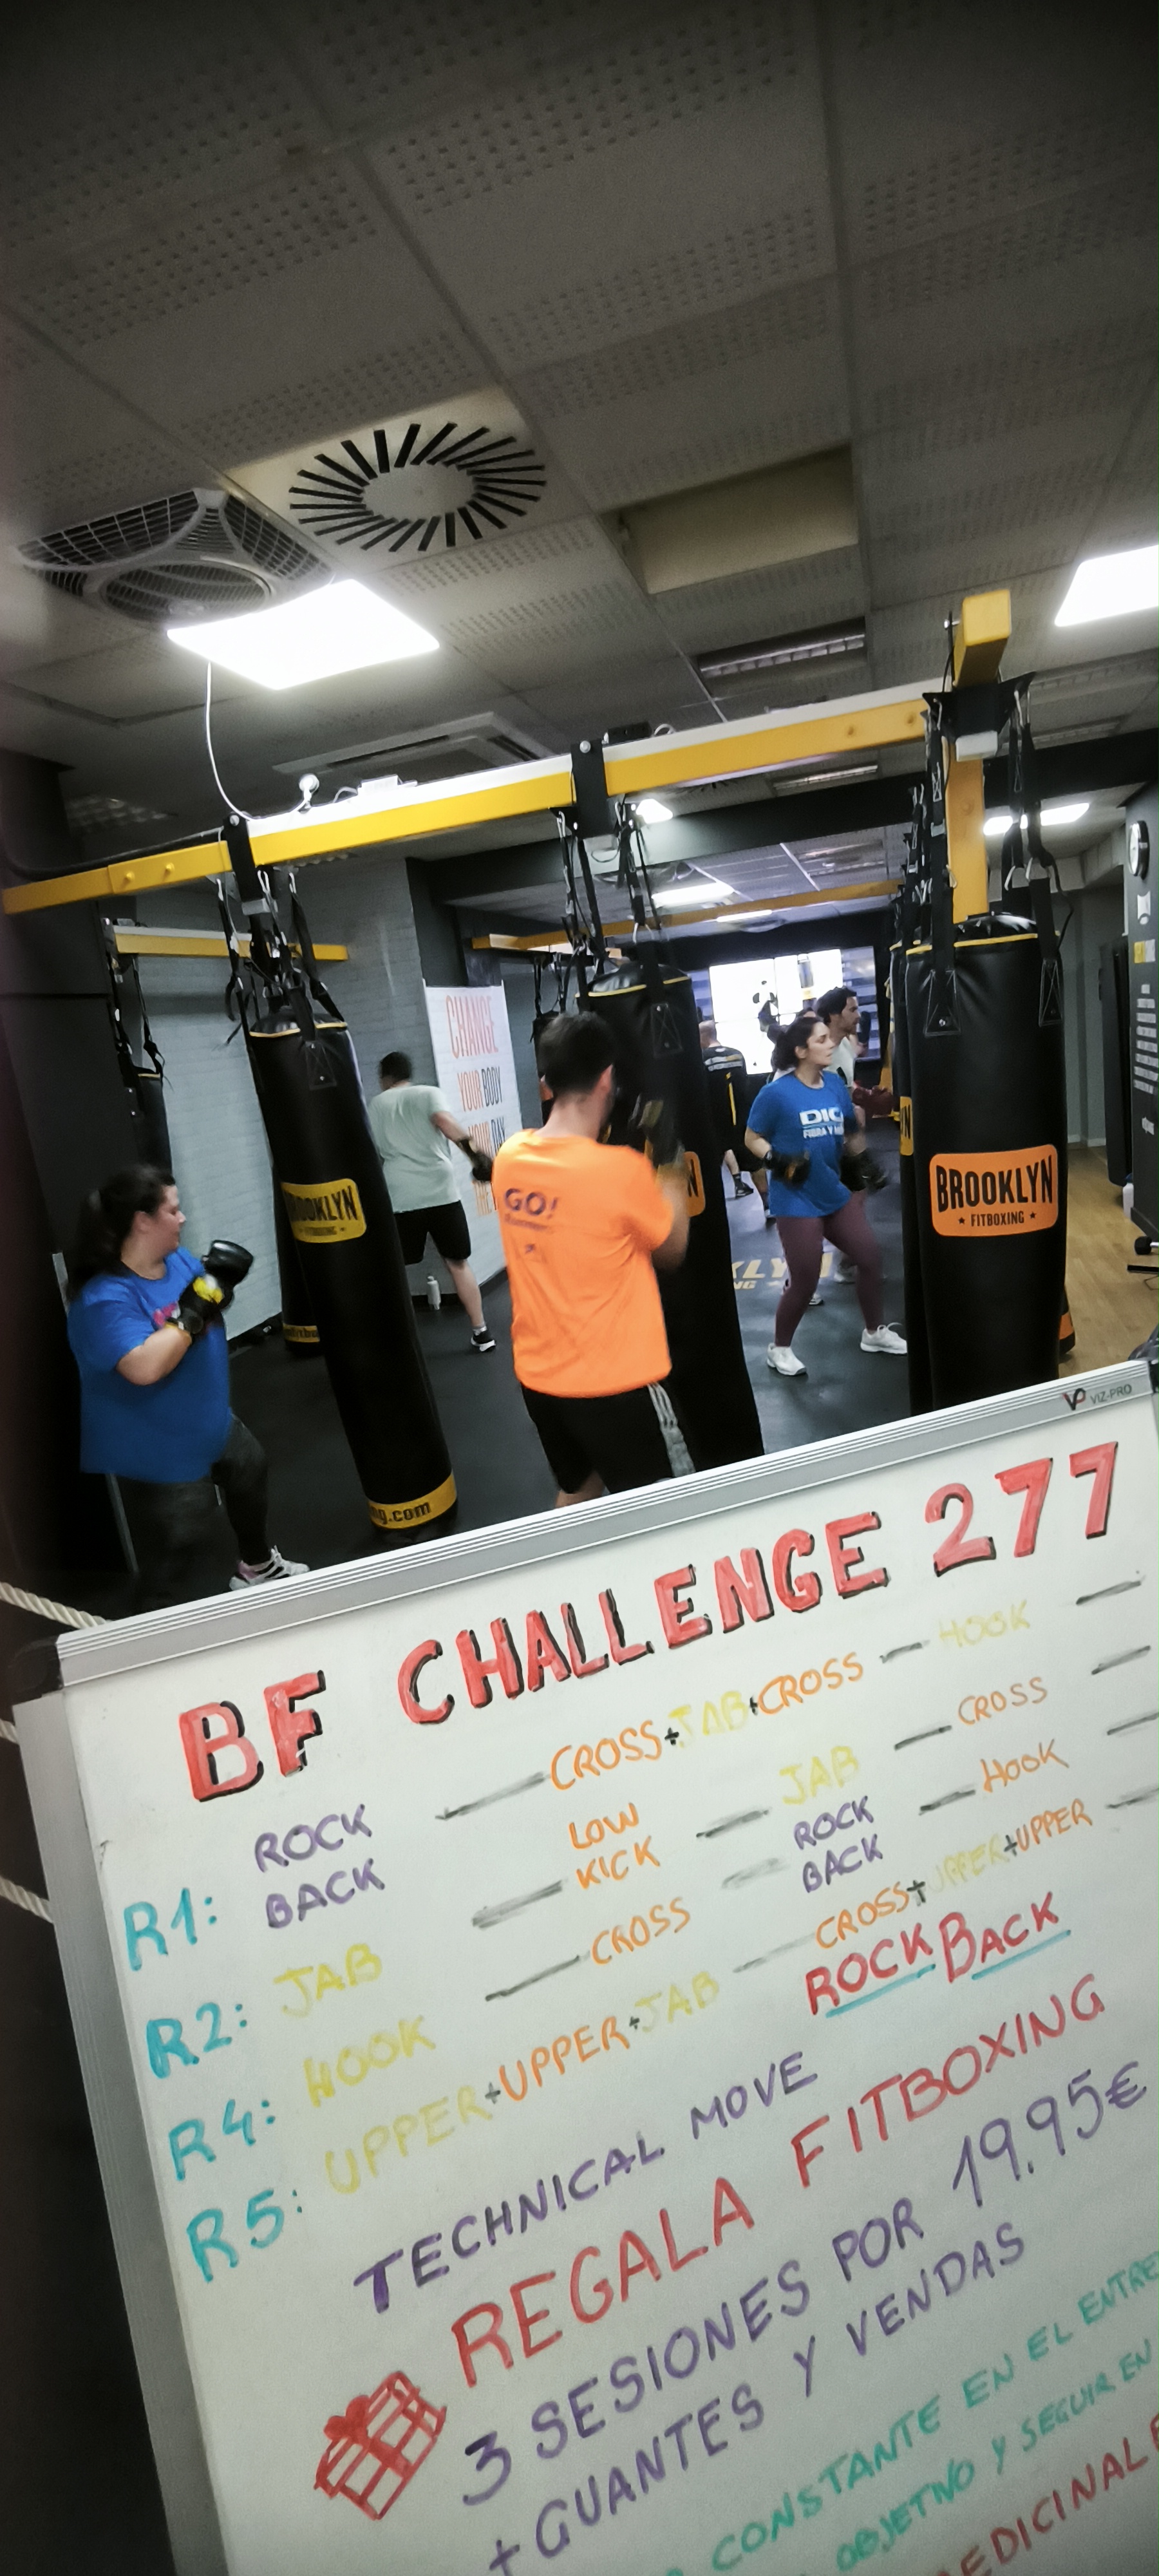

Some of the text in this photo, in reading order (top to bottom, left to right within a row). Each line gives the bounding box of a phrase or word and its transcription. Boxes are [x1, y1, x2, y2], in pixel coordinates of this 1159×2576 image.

[446, 995, 498, 1059] CHANGE
[458, 1066, 503, 1112] YOUR BODY
[283, 1186, 358, 1222] OOKLYN
[505, 1188, 558, 1219] GO!
[936, 1155, 1053, 1213] BROOKLYN
[971, 1211, 1024, 1227] FITBOXING
[1090, 1384, 1133, 1404] VIZ-PRO
[178, 1441, 1118, 1802] BF CHALLENGE 277
[939, 1600, 1032, 1650] HOOK
[146, 1677, 1048, 2079] R2: JAB LOW KICK JAB CROSS
[254, 1804, 373, 1872] ROCK
[124, 1888, 218, 1971] R1:
[265, 1858, 385, 1929] BACK
[168, 1738, 1069, 2181] R4: HOOK CROSS ROCK BACK HOOK
[353, 1891, 1059, 2313] TECHNICAL MOVE ROCK BACK
[451, 1974, 1105, 2388] REGALA FITBOXING
[187, 2189, 303, 2284] R5:
[463, 2061, 1147, 2506] 3 SESIONES POR 19.95€
[536, 2385, 765, 2558] GUANTES
[793, 2335, 815, 2398] Y
[846, 2223, 1024, 2356] VENDAS
[991, 2435, 1006, 2475] Y
[1022, 2372, 1116, 2452] SEGUIR
[1118, 2338, 1152, 2382] EN
[711, 2394, 940, 2571] CONSTANTE
[962, 2353, 1014, 2409] EN
[1027, 2322, 1074, 2362] EL
[936, 2412, 1159, 2576] EDICINAL
